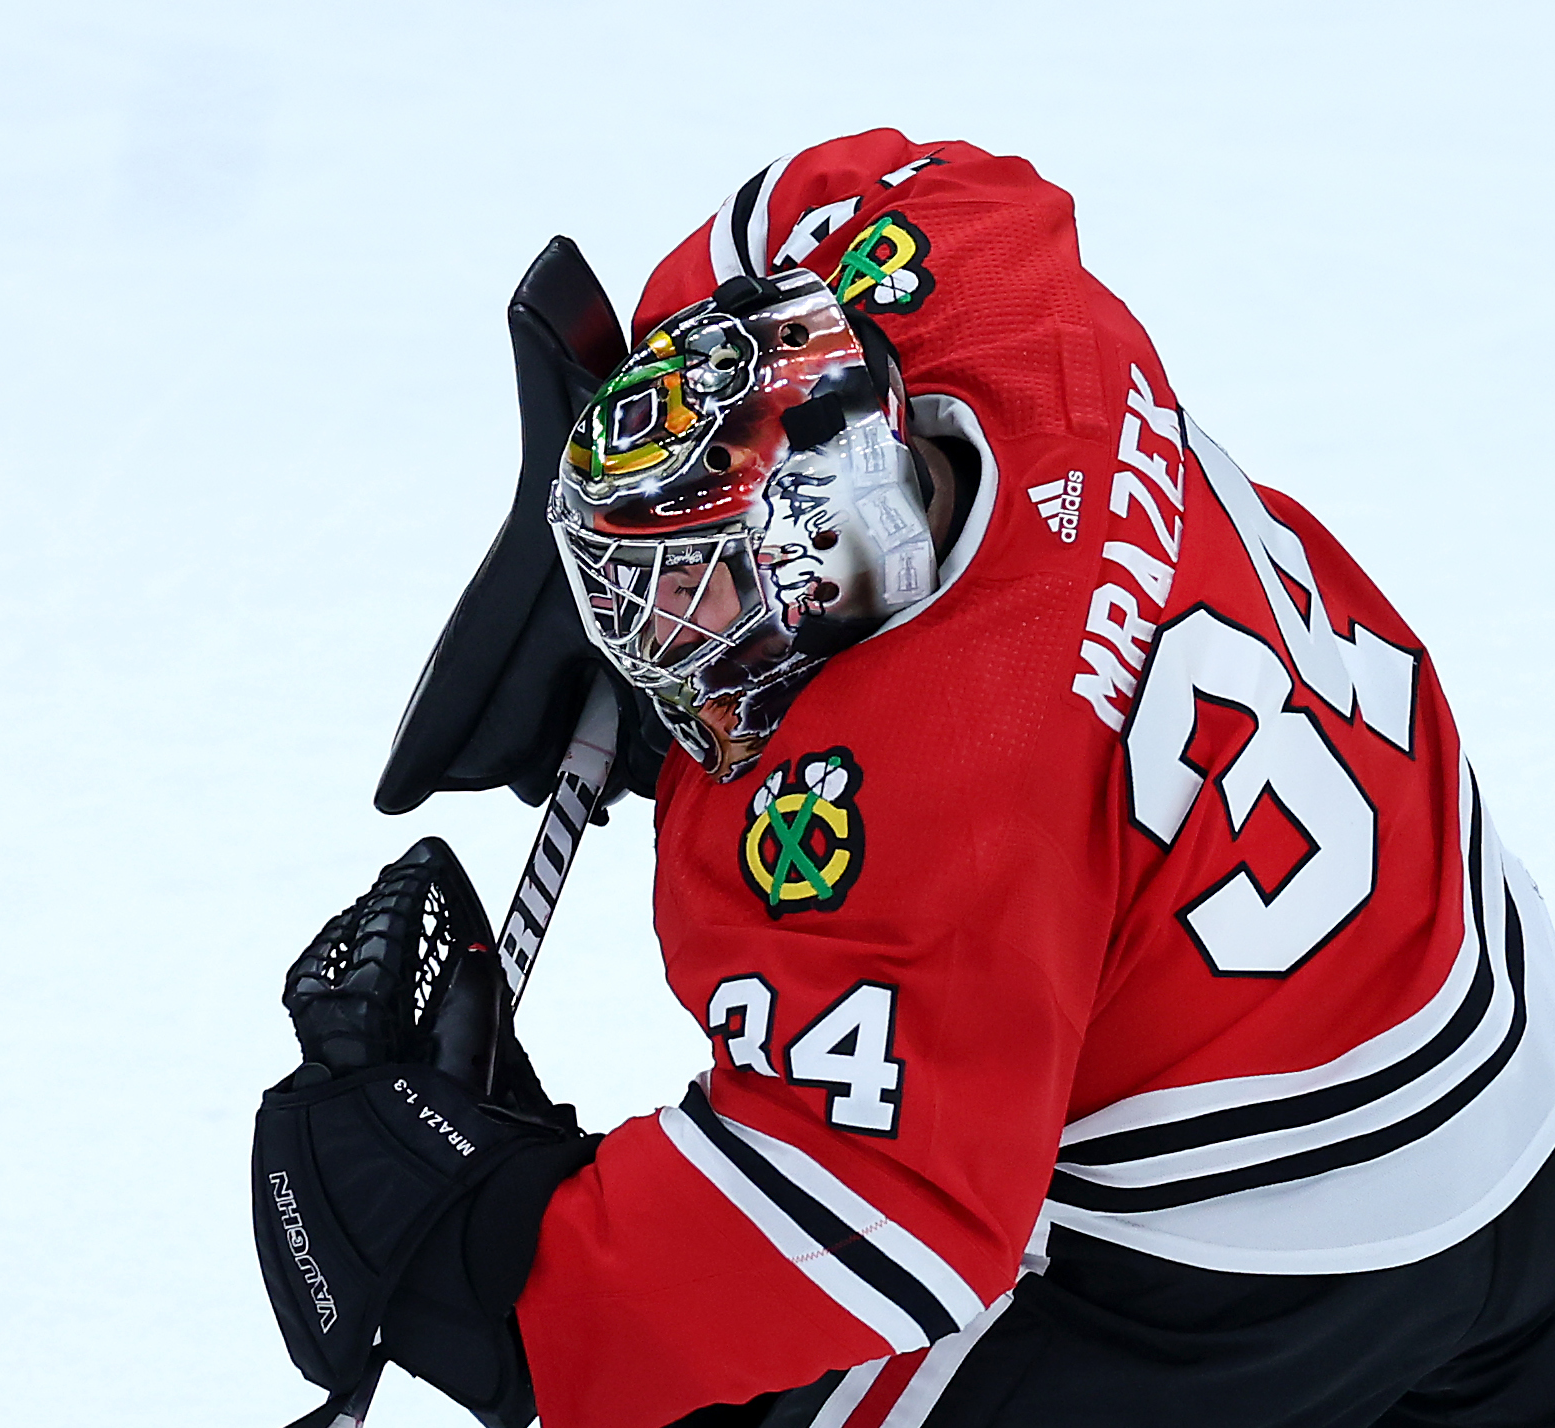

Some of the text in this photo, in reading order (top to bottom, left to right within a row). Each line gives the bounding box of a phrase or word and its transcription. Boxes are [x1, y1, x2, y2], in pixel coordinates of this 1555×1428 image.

[1061, 470, 1083, 543] adidas
[1071, 362, 1185, 733] MRAZEK
[1122, 401, 1423, 978] 34
[393, 1078, 475, 1156] MRAZA 1-3
[708, 971, 905, 1139] 34
[268, 1170, 339, 1335] VAUGHN
